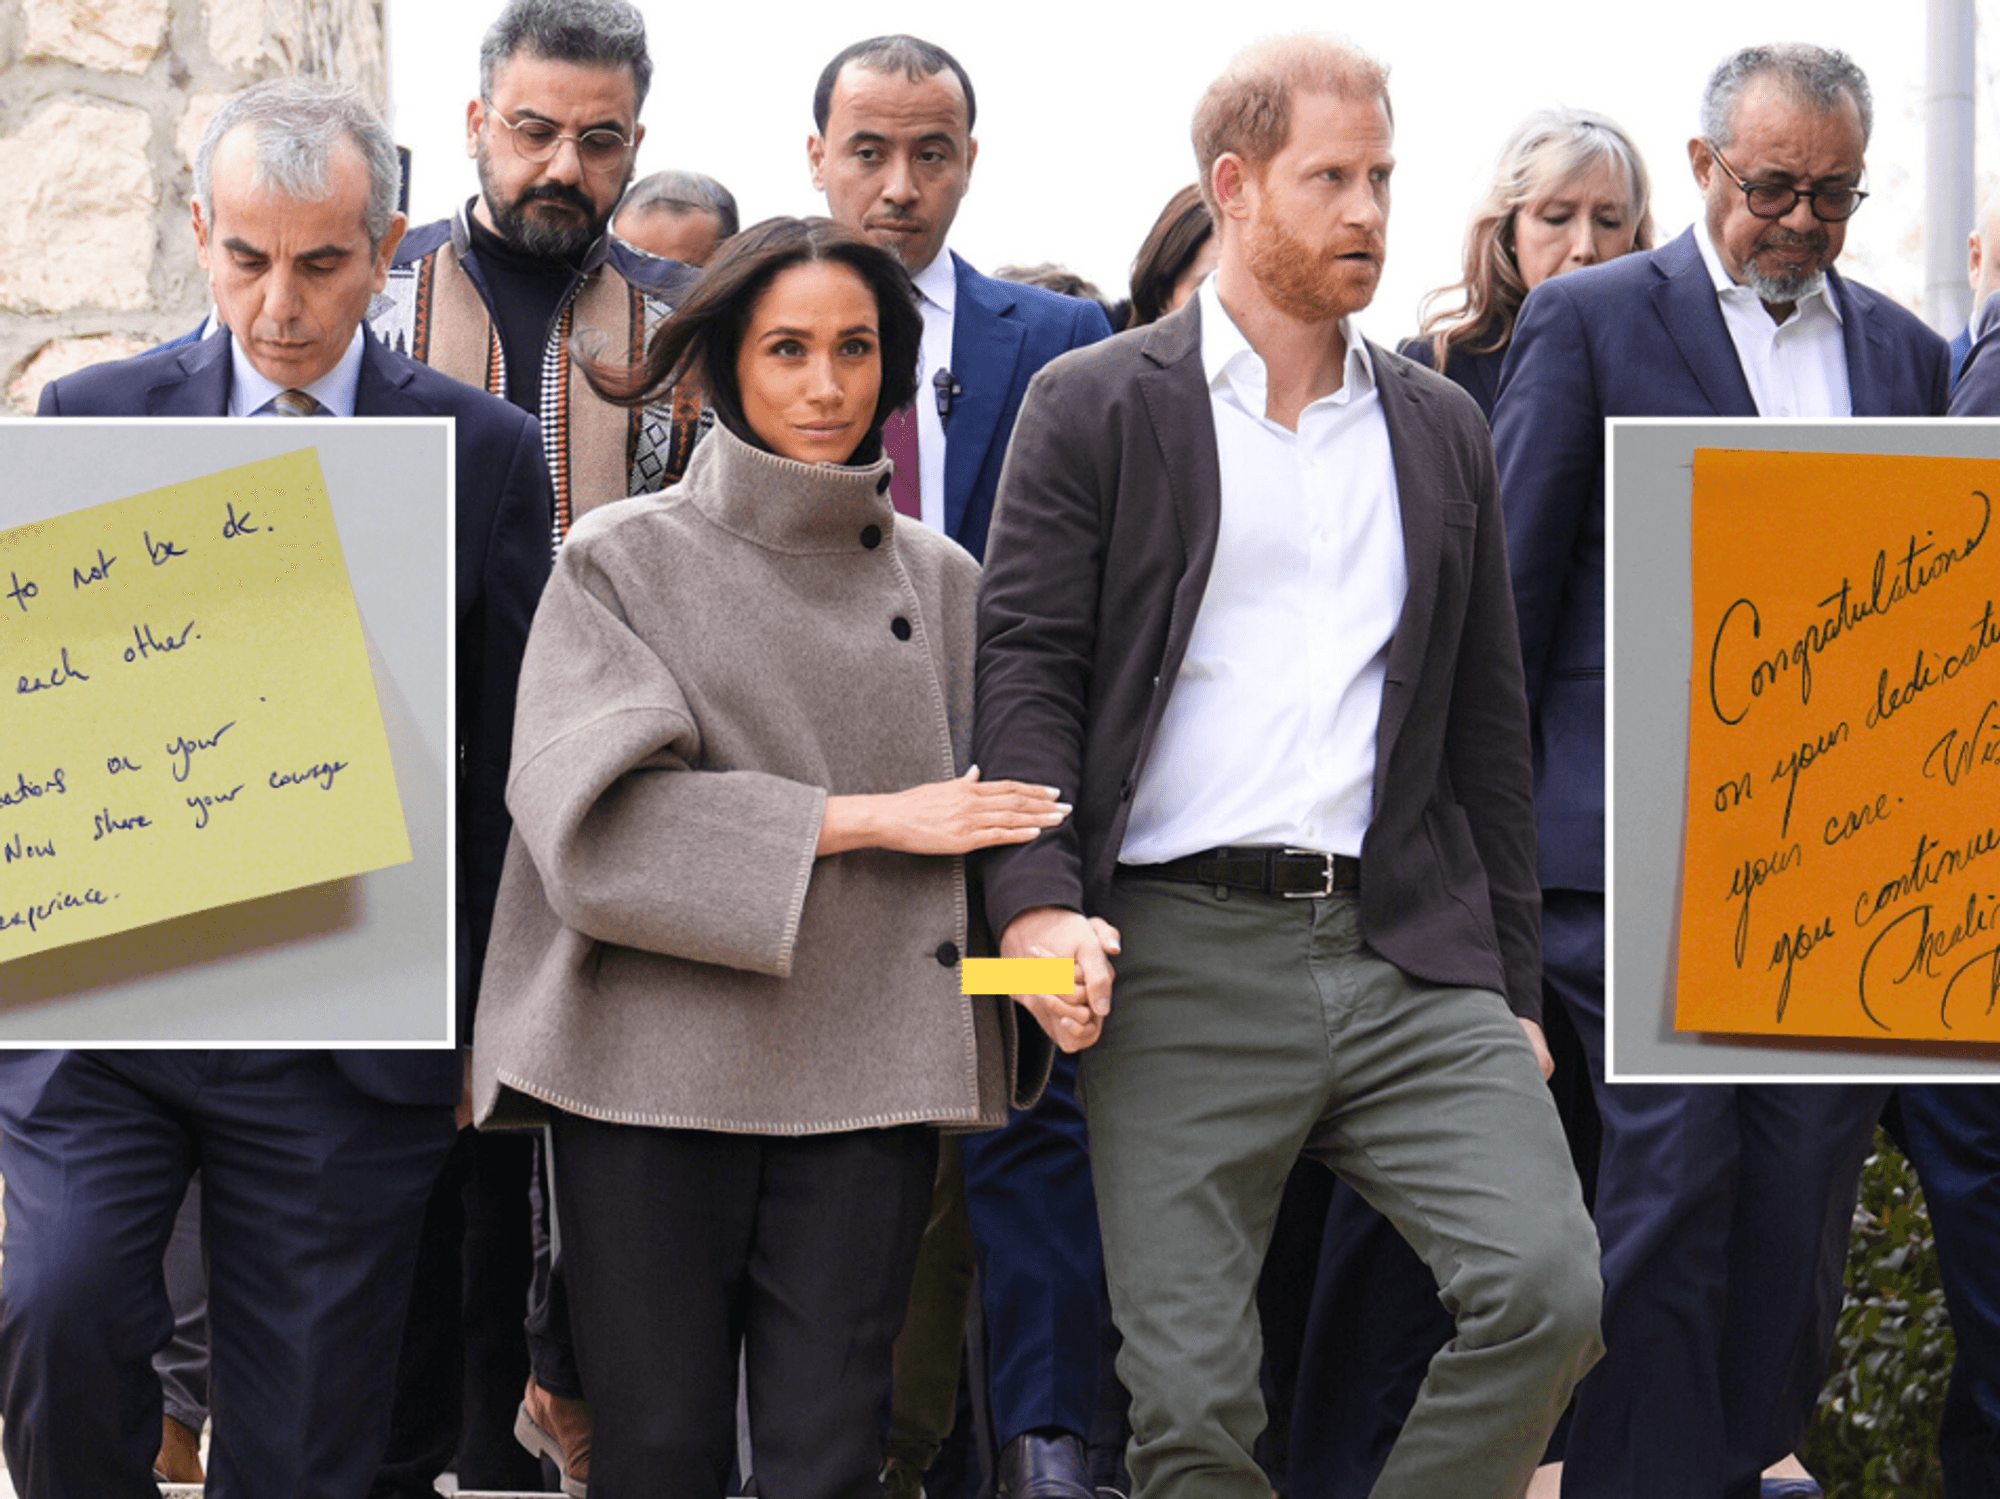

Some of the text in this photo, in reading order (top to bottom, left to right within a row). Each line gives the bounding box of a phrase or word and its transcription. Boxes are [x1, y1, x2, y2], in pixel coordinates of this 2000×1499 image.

[7, 570, 38, 611] to
[72, 549, 117, 590] not
[144, 530, 188, 566] be
[1710, 490, 1992, 726] Congratulations
[16, 619, 202, 696] each other.
[107, 756, 142, 775] on
[166, 720, 236, 782] your
[1714, 600, 2000, 840] on your dedicati
[4, 761, 349, 864] Now share your courage
[1725, 843, 1803, 971] your
[1823, 793, 1905, 848] care.
[1768, 915, 1835, 1025] you
